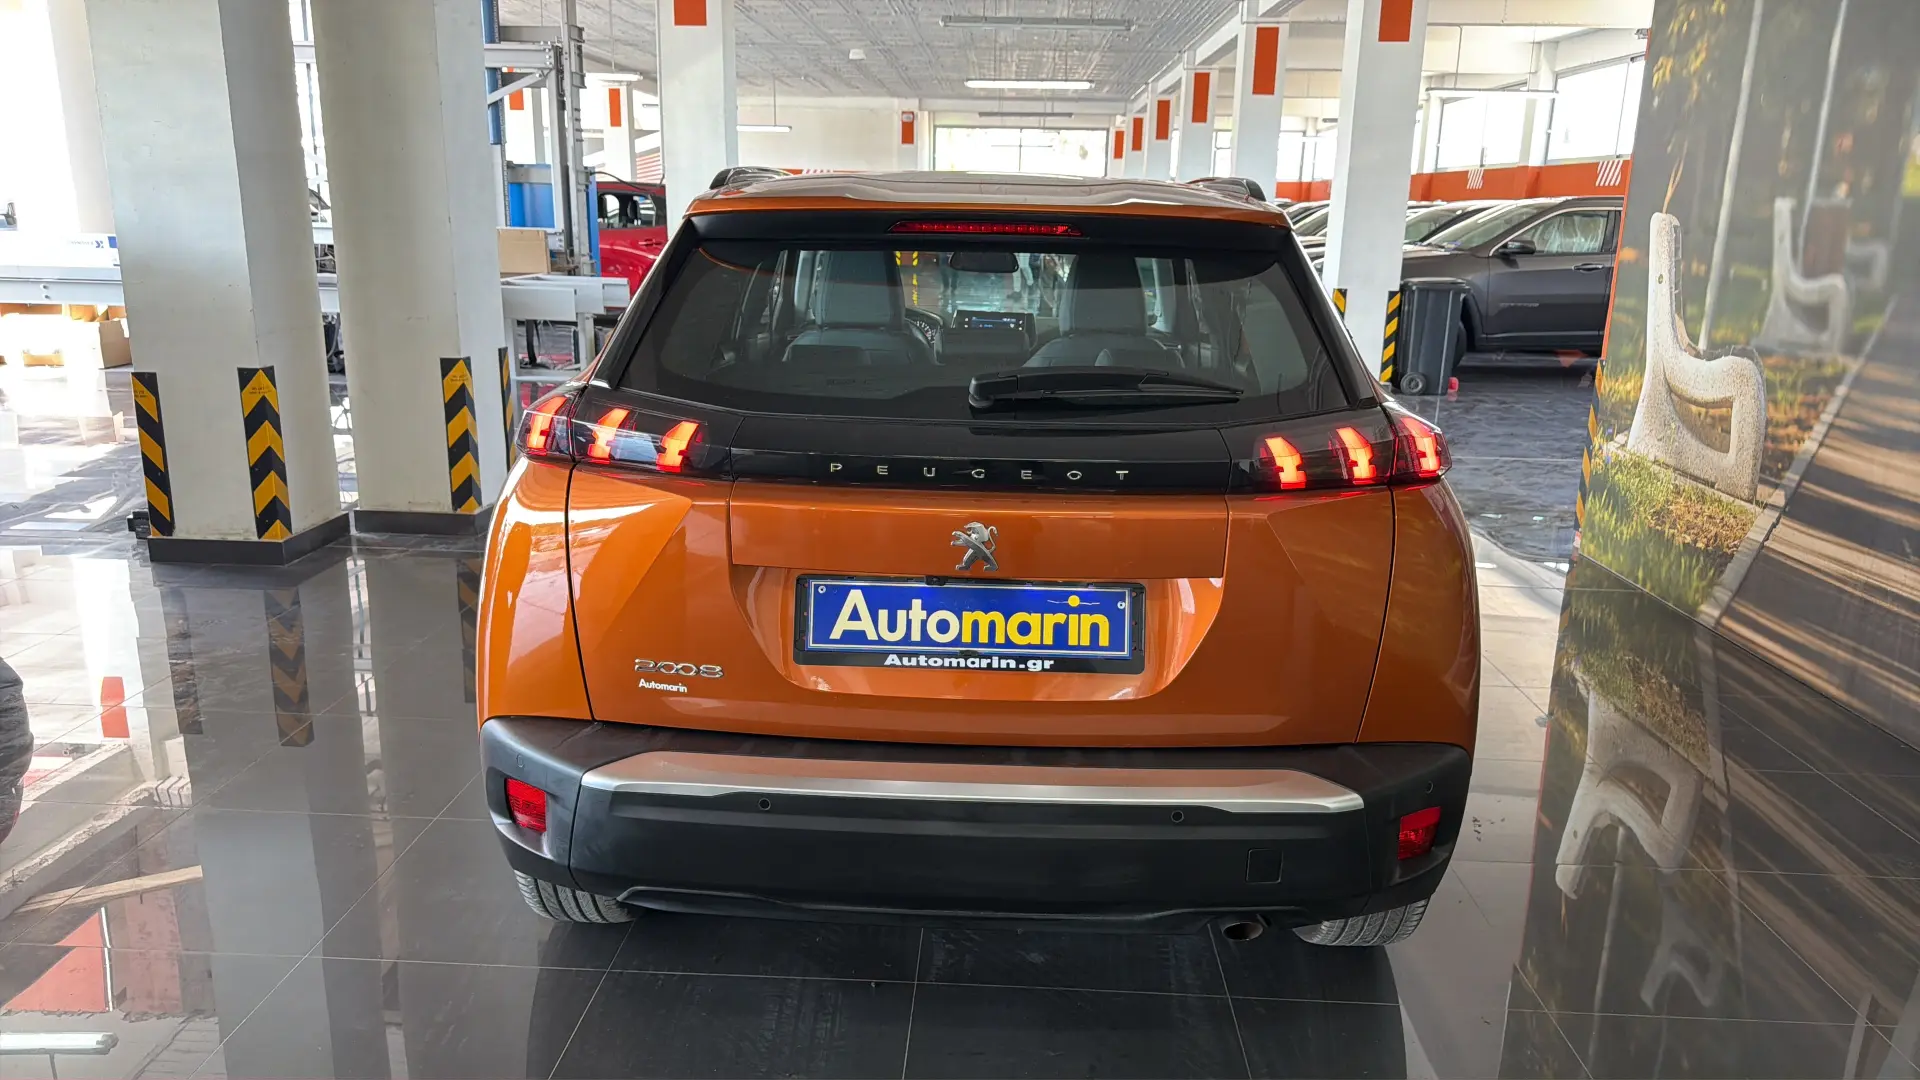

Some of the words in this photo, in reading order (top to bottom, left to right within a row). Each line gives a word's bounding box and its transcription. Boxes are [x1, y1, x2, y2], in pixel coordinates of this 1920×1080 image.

[830, 463, 1129, 481] PEUGEOT
[829, 588, 1110, 647] Automarin
[634, 658, 723, 678] 2008
[883, 653, 1055, 672] Automarin.gr
[638, 678, 688, 693] Automarin
